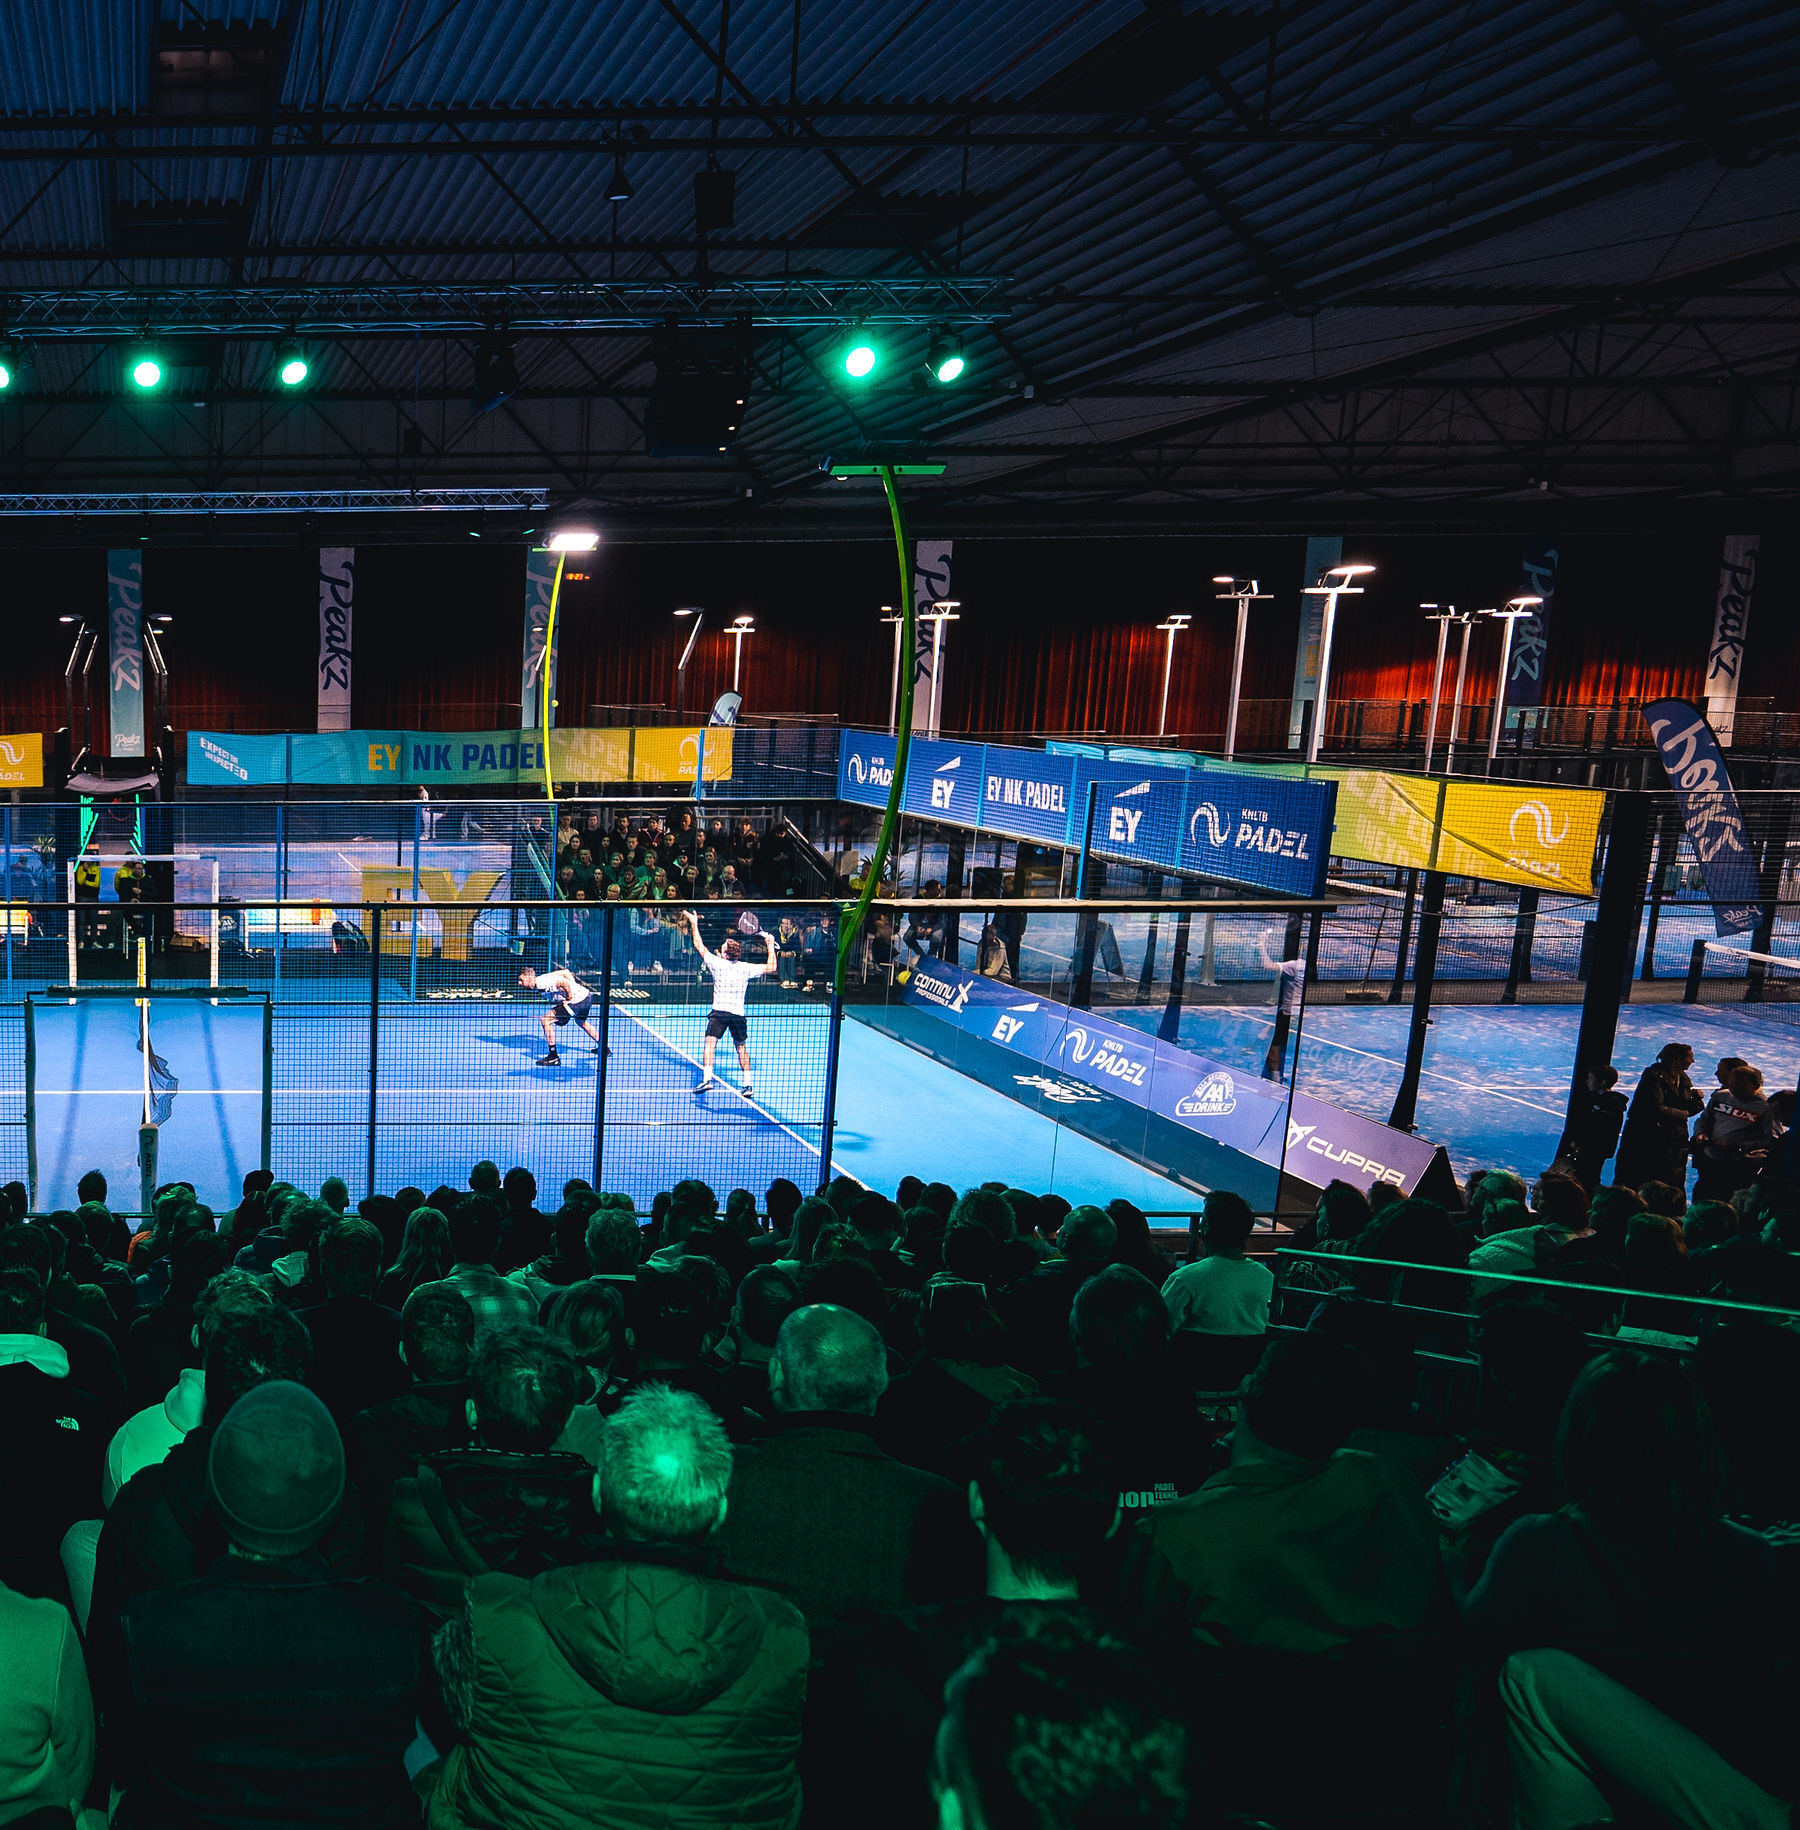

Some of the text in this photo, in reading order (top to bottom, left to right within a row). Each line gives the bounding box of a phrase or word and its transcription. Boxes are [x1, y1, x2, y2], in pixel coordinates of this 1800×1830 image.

[107, 561, 142, 692] Peakz
[318, 561, 353, 691] Peakz
[1710, 549, 1757, 680] Peakz
[368, 744, 401, 771] EY
[413, 744, 452, 771] NK
[869, 766, 894, 787] PAD
[931, 778, 955, 809] EY
[987, 775, 1066, 813] EY NK PADEL
[1109, 806, 1143, 843] EY
[1242, 808, 1268, 822] KNLTB
[1235, 823, 1309, 860] PADEL
[361, 864, 506, 962] EY
[914, 973, 956, 999] CONTINU
[992, 1014, 1024, 1043] EY
[1089, 1050, 1147, 1087] PADEL
[1192, 1102, 1226, 1113] DRINK
[1201, 1083, 1225, 1102] AA
[1713, 1103, 1757, 1123] SIUX
[1306, 1136, 1406, 1187] CUPRA
[1154, 1482, 1175, 1491] PADEL
